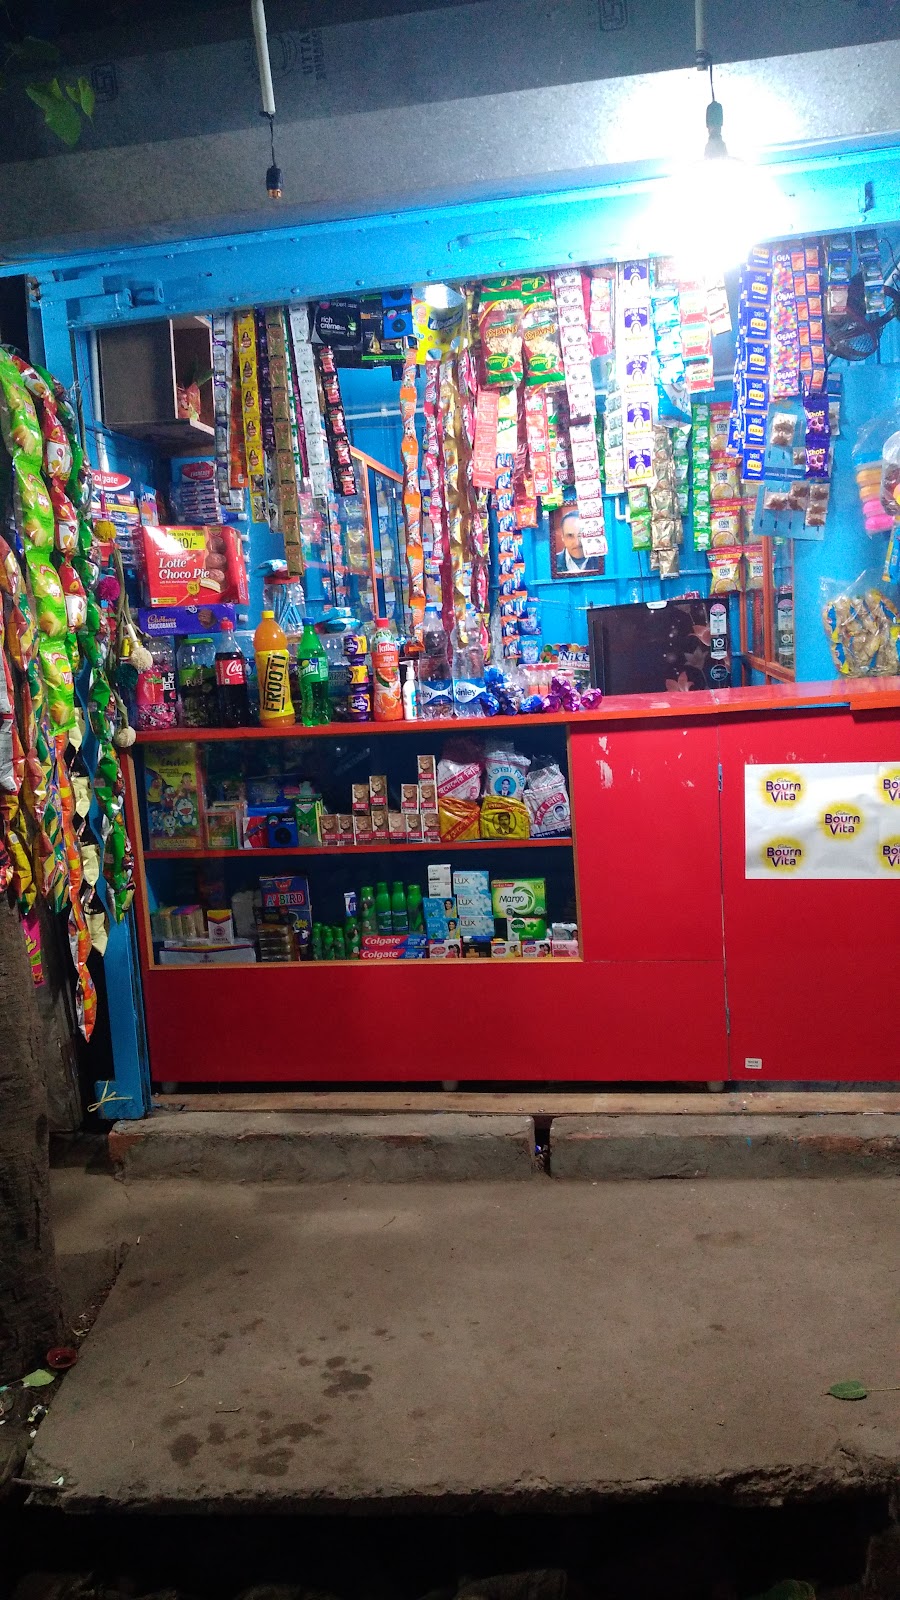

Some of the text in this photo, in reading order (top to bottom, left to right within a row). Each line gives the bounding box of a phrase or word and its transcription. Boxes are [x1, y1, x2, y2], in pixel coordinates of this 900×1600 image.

[776, 370, 797, 380] GEMS
[92, 472, 118, 485] Colgate
[159, 558, 187, 568] Lotte
[159, 568, 210, 579] Choco Pie
[713, 639, 724, 648] 10
[266, 655, 286, 712] FROOTI
[766, 780, 801, 792] Bourn
[883, 779, 900, 790] Bo
[771, 792, 796, 802] Vita
[824, 814, 860, 825] Bourn
[830, 824, 855, 835] Vita
[767, 847, 802, 858] Bourn
[883, 846, 900, 856] Bo
[772, 857, 796, 867] Vita
[279, 893, 304, 906] BIRD
[499, 895, 524, 903] Margo
[365, 937, 401, 946] Colgate
[362, 951, 398, 959] Colgate
